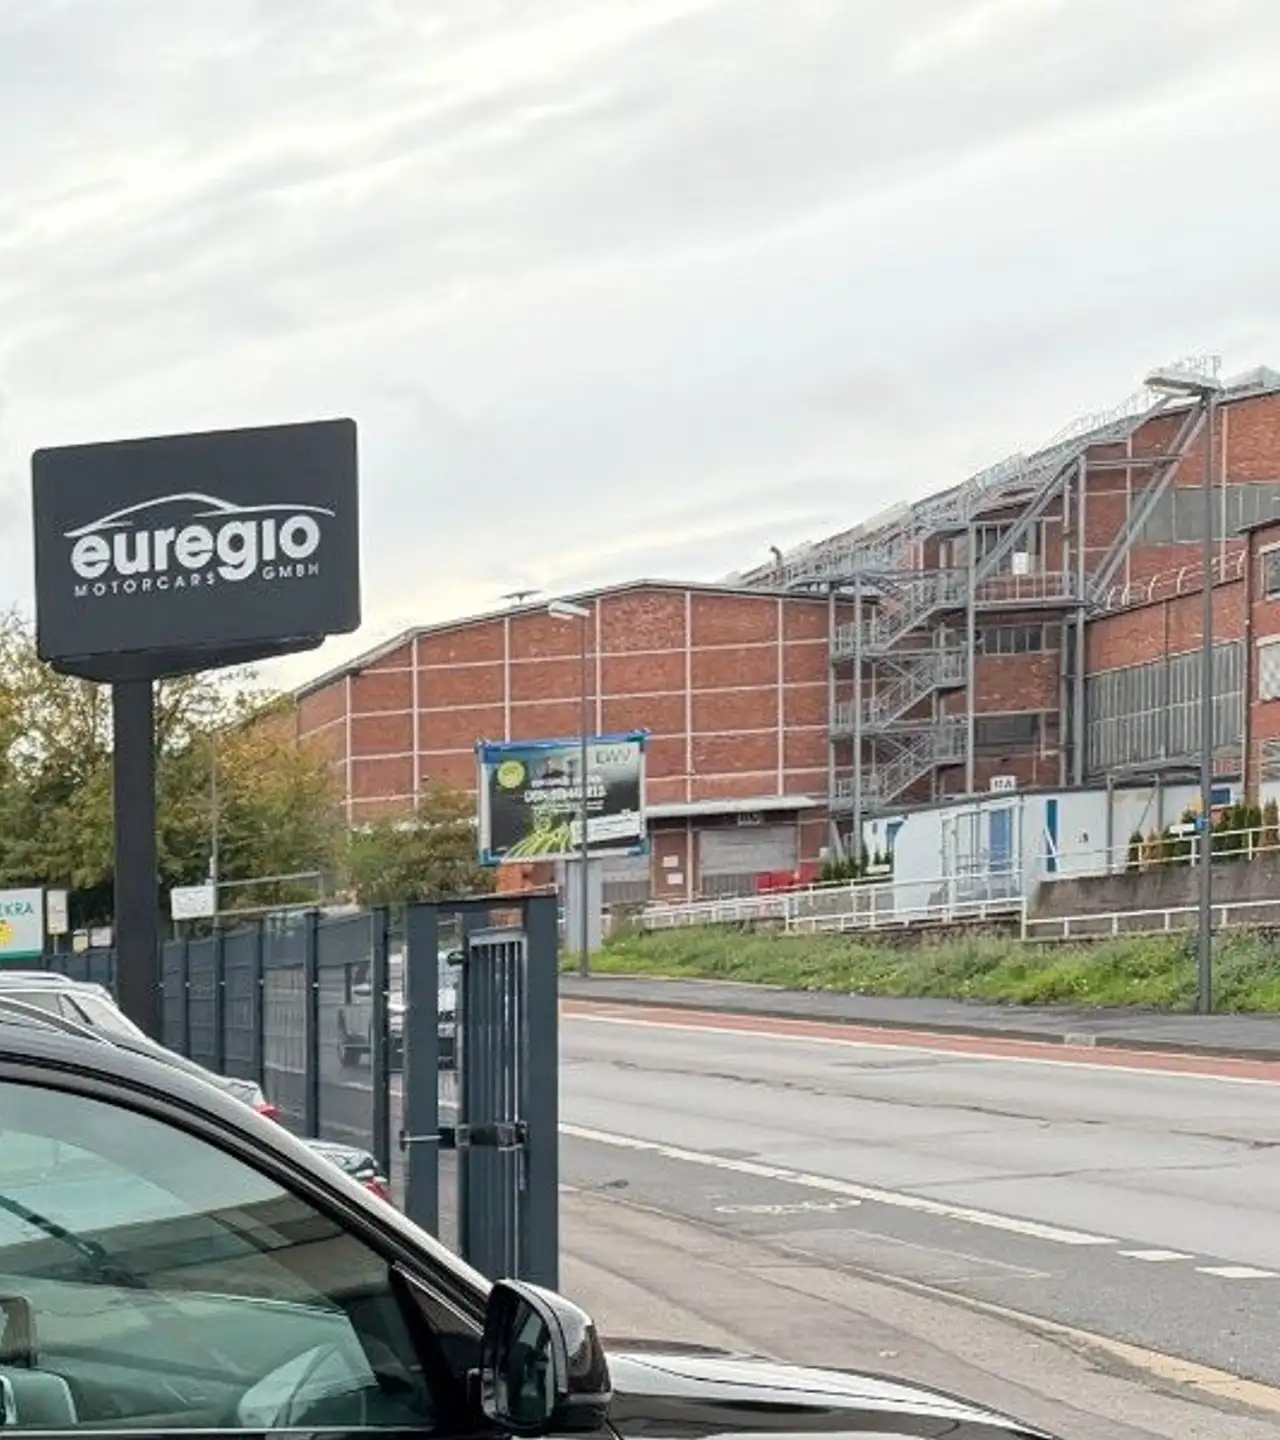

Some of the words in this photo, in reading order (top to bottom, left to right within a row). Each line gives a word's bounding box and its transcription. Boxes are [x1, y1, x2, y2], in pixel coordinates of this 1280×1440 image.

[70, 514, 321, 582] euregio
[74, 571, 217, 598] MOTORCARS
[262, 562, 320, 581] GMBH
